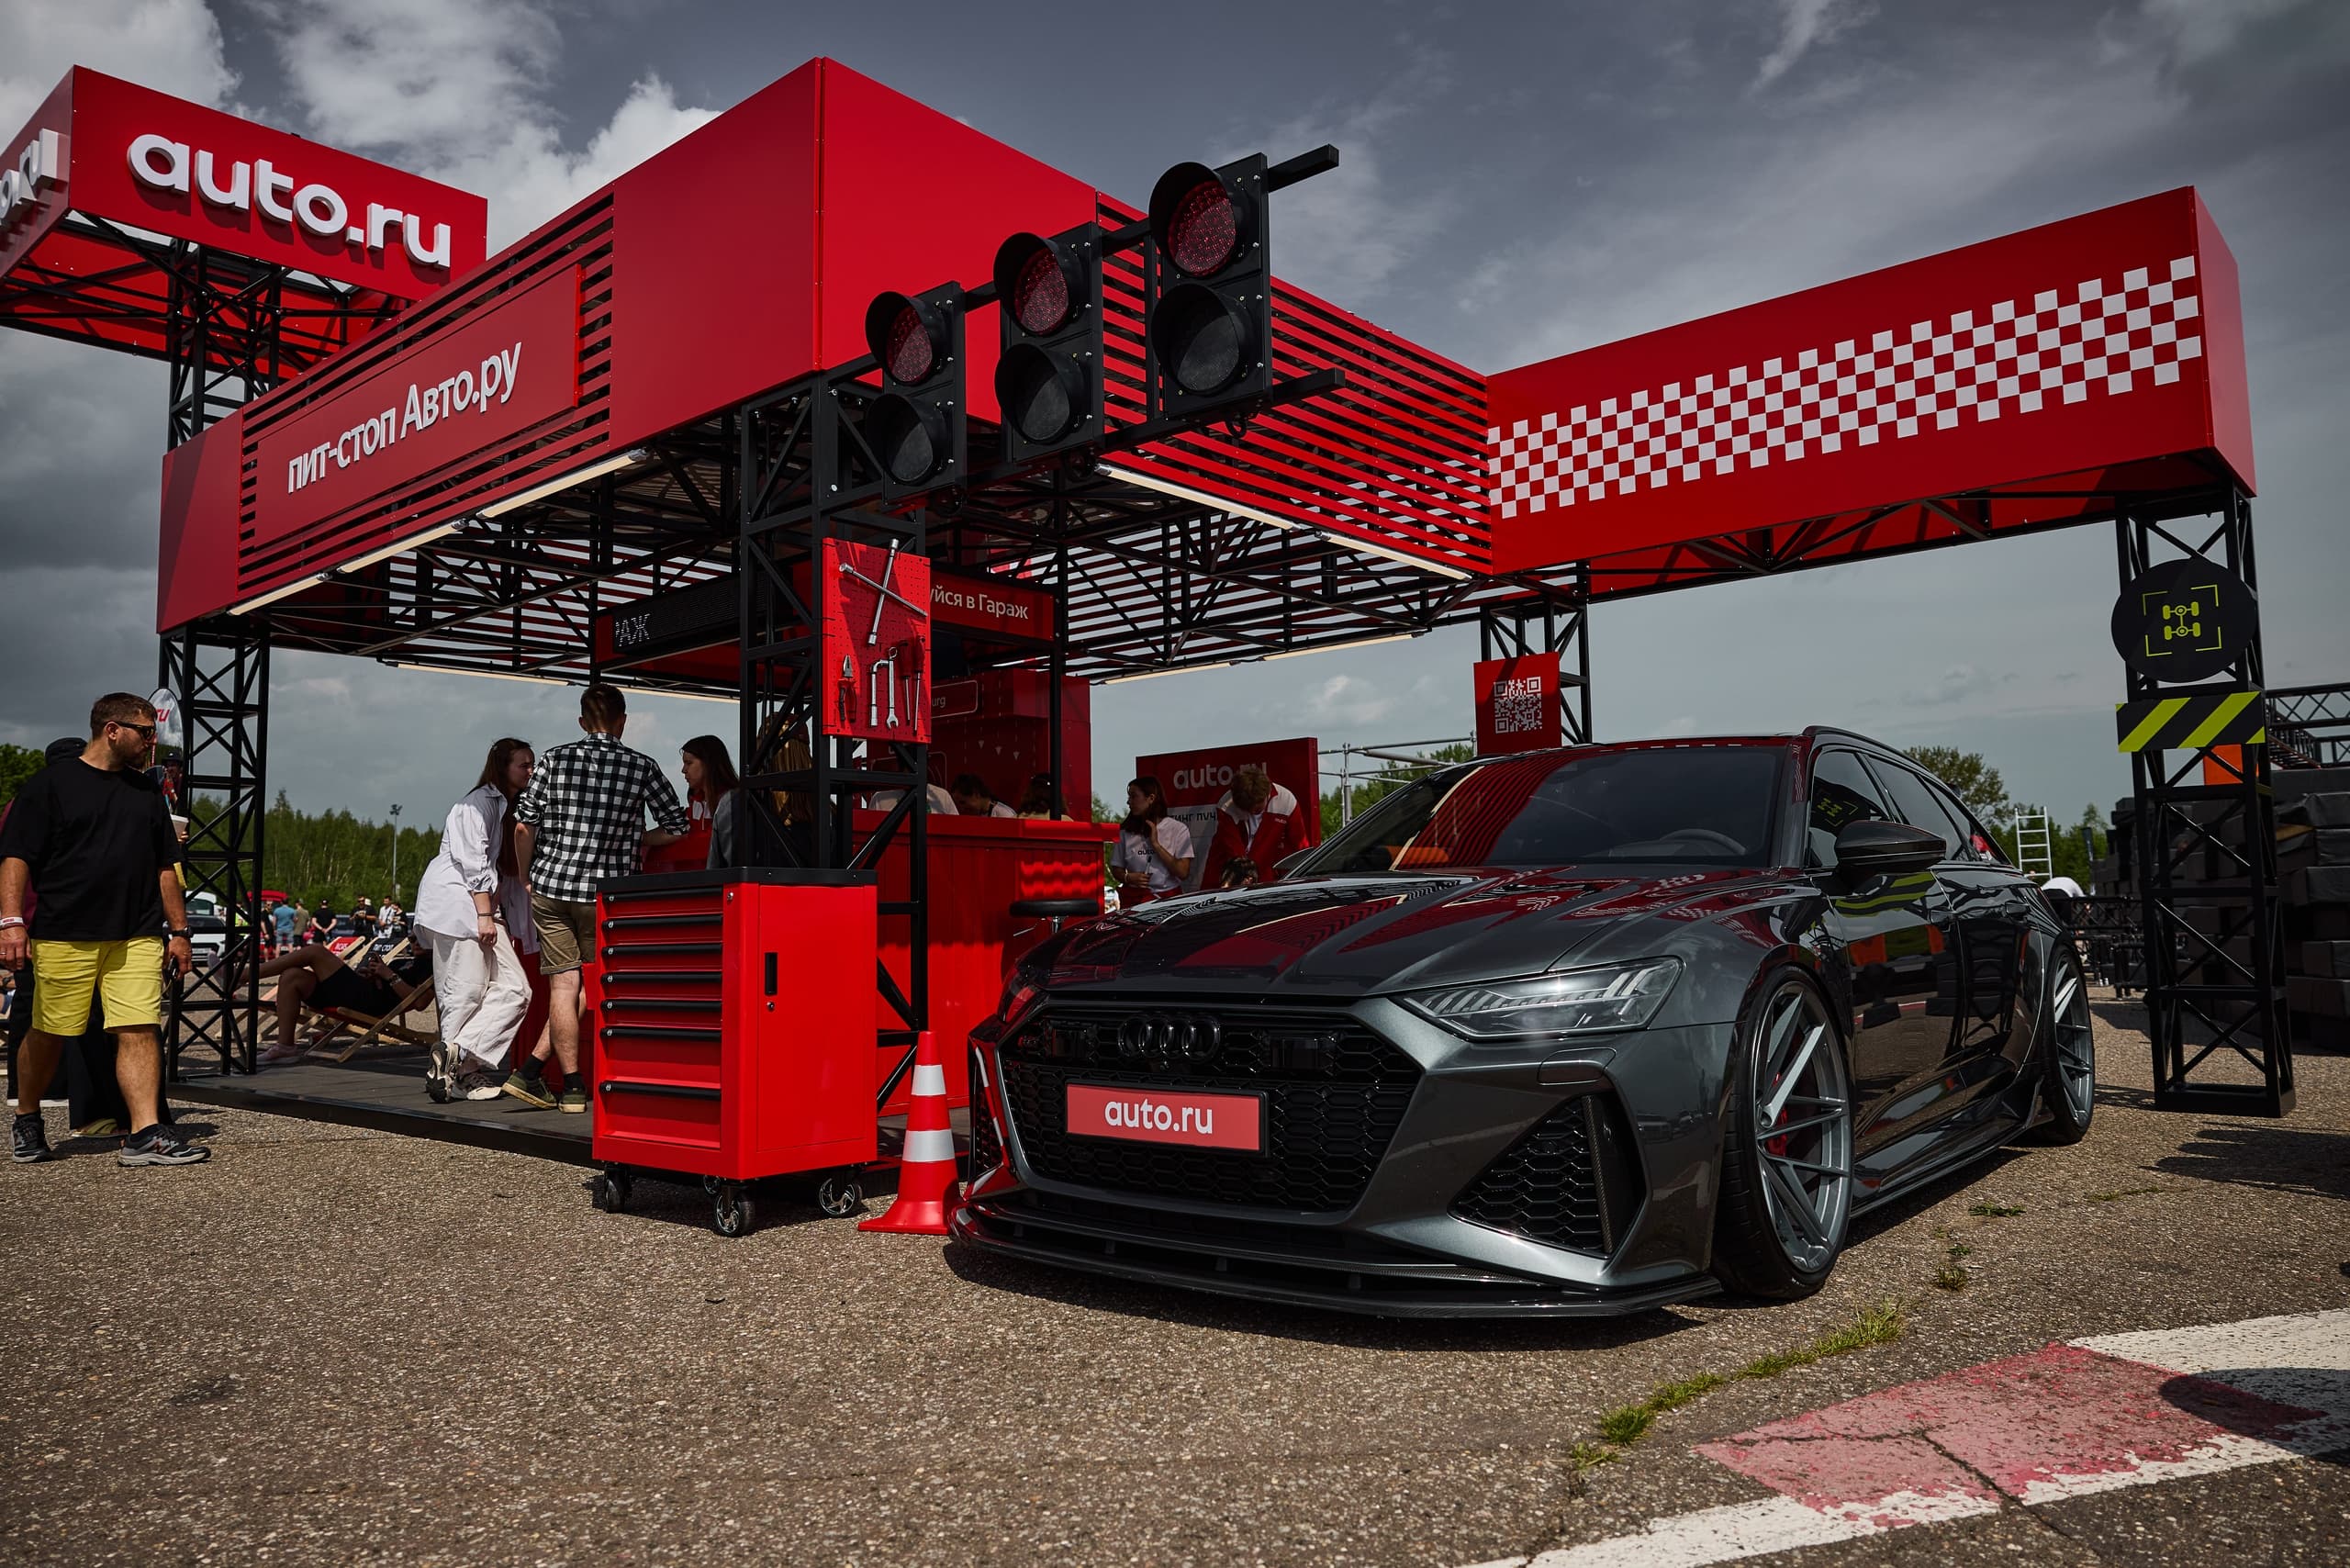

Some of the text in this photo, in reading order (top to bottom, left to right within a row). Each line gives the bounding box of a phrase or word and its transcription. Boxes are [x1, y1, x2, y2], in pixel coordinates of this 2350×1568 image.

[127, 134, 451, 268] auto.ru
[288, 342, 521, 493] пит-стоп Авто.ру
[966, 596, 976, 609] в
[979, 593, 1029, 619] Гараж
[1104, 1099, 1213, 1135] auto.ru
